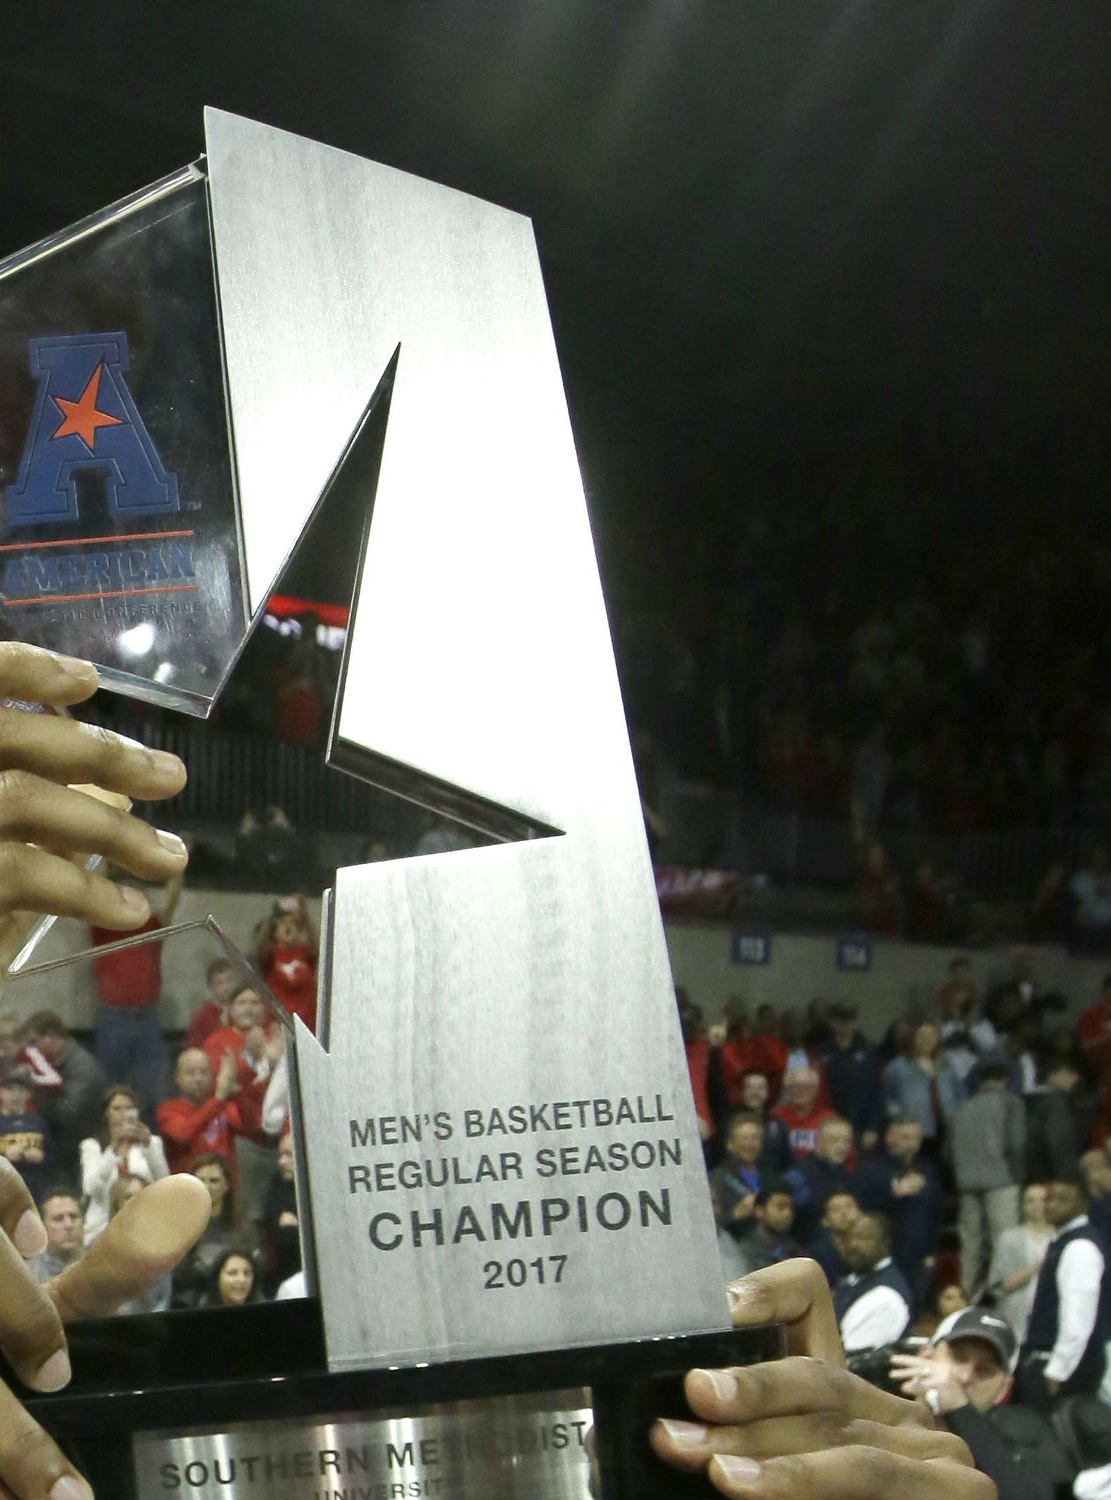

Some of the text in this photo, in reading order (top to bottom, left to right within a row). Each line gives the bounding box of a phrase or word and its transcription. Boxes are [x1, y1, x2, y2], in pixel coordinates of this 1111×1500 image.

[3, 545, 196, 594] AMERICAN
[349, 1093, 674, 1148] MEN'S BASKETBALL
[348, 1137, 683, 1194] REGULAR SEASON
[368, 1187, 673, 1251] CHAMPION
[482, 1254, 568, 1290] 2017
[158, 1445, 369, 1491] SOUTHERN
